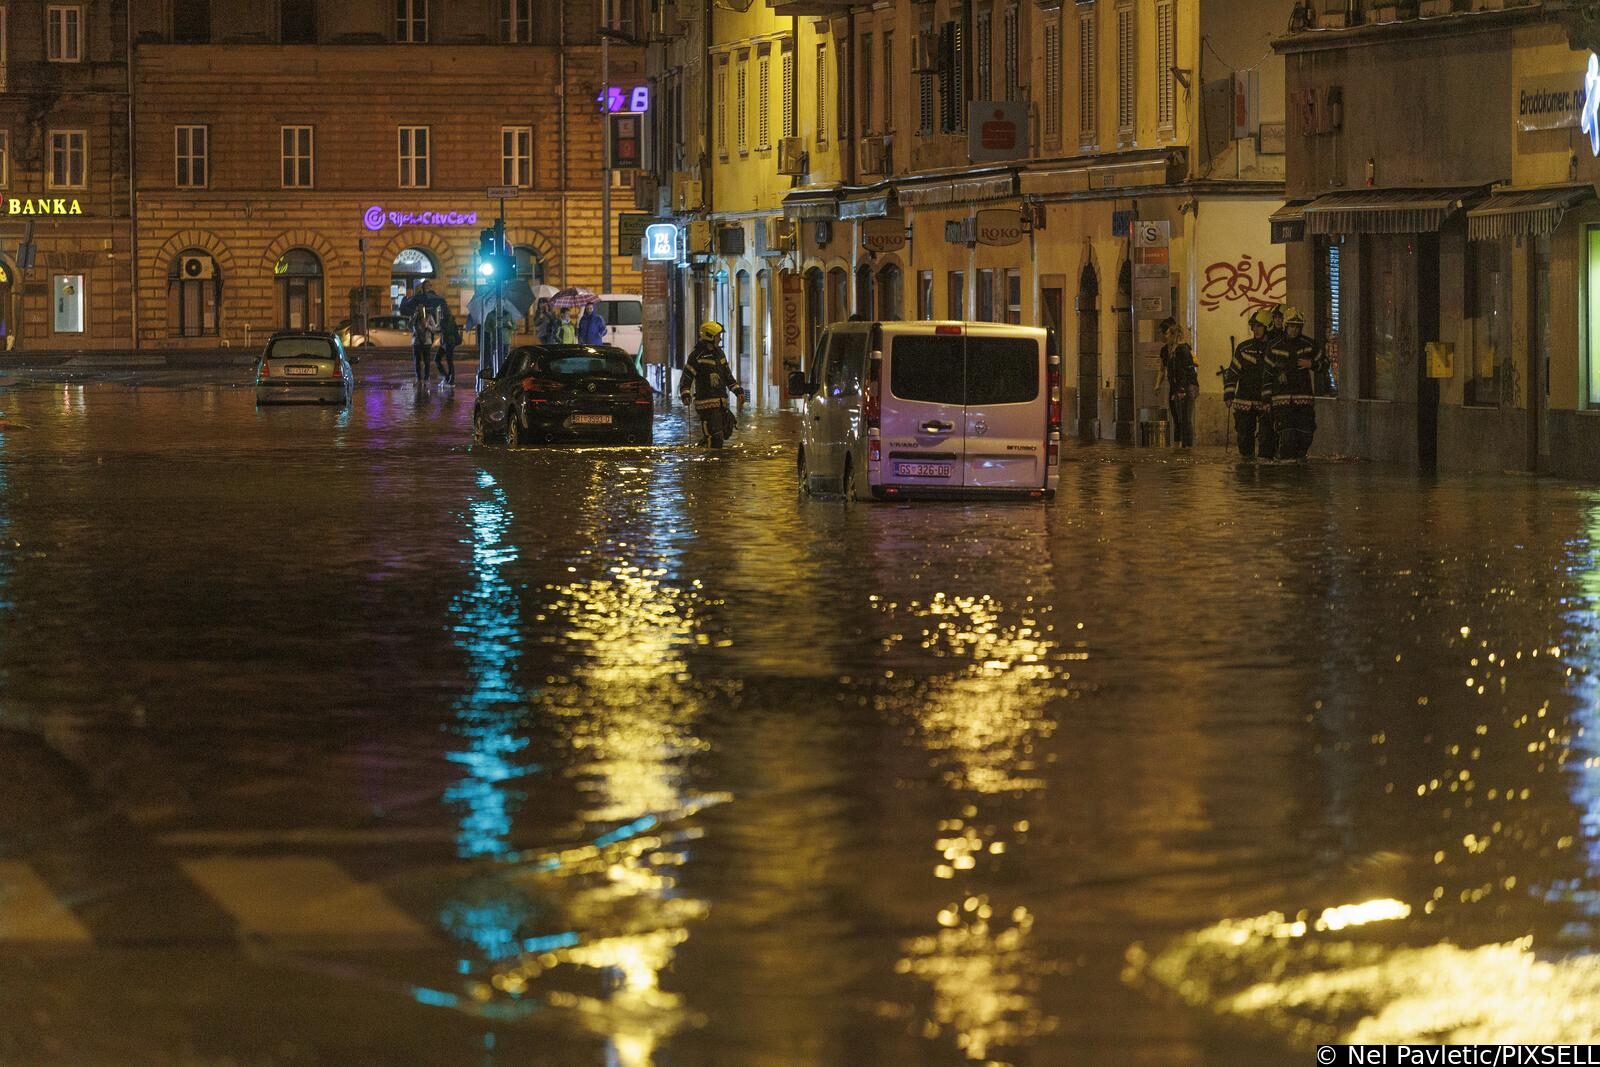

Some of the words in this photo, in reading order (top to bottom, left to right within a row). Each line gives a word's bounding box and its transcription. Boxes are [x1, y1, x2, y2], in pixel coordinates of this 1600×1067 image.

[8, 198, 82, 215] BANKA
[981, 228, 1020, 241] ROKO
[1146, 228, 1157, 241] S
[868, 235, 903, 248] ROKO
[900, 464, 911, 474] GS
